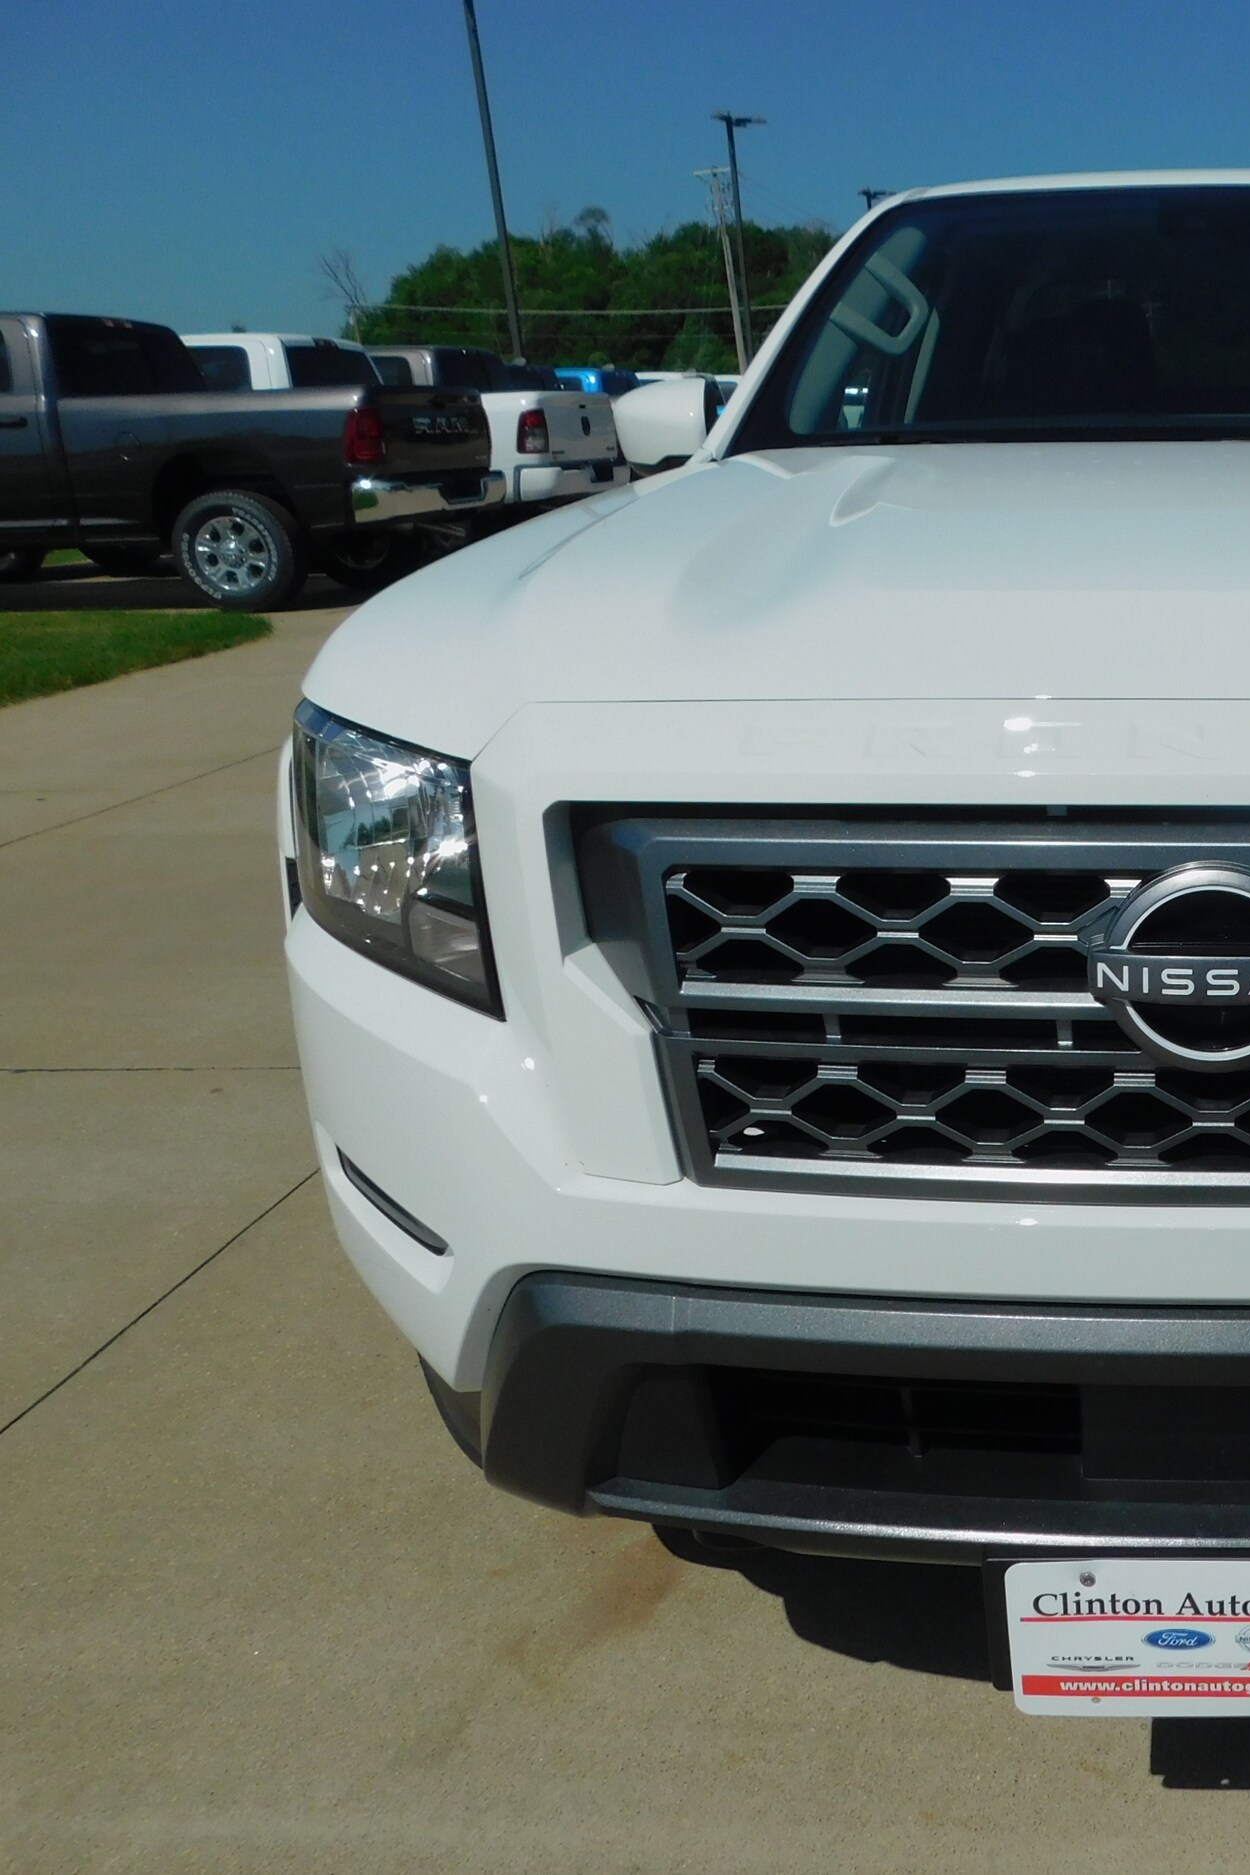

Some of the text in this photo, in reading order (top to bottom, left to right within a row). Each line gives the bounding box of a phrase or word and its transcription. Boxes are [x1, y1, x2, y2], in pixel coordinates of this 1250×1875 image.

[413, 416, 478, 435] RAM
[1032, 1592, 1165, 1617] Clinton
[1157, 1631, 1199, 1647] Ford
[1156, 1661, 1245, 1669] DODGE
